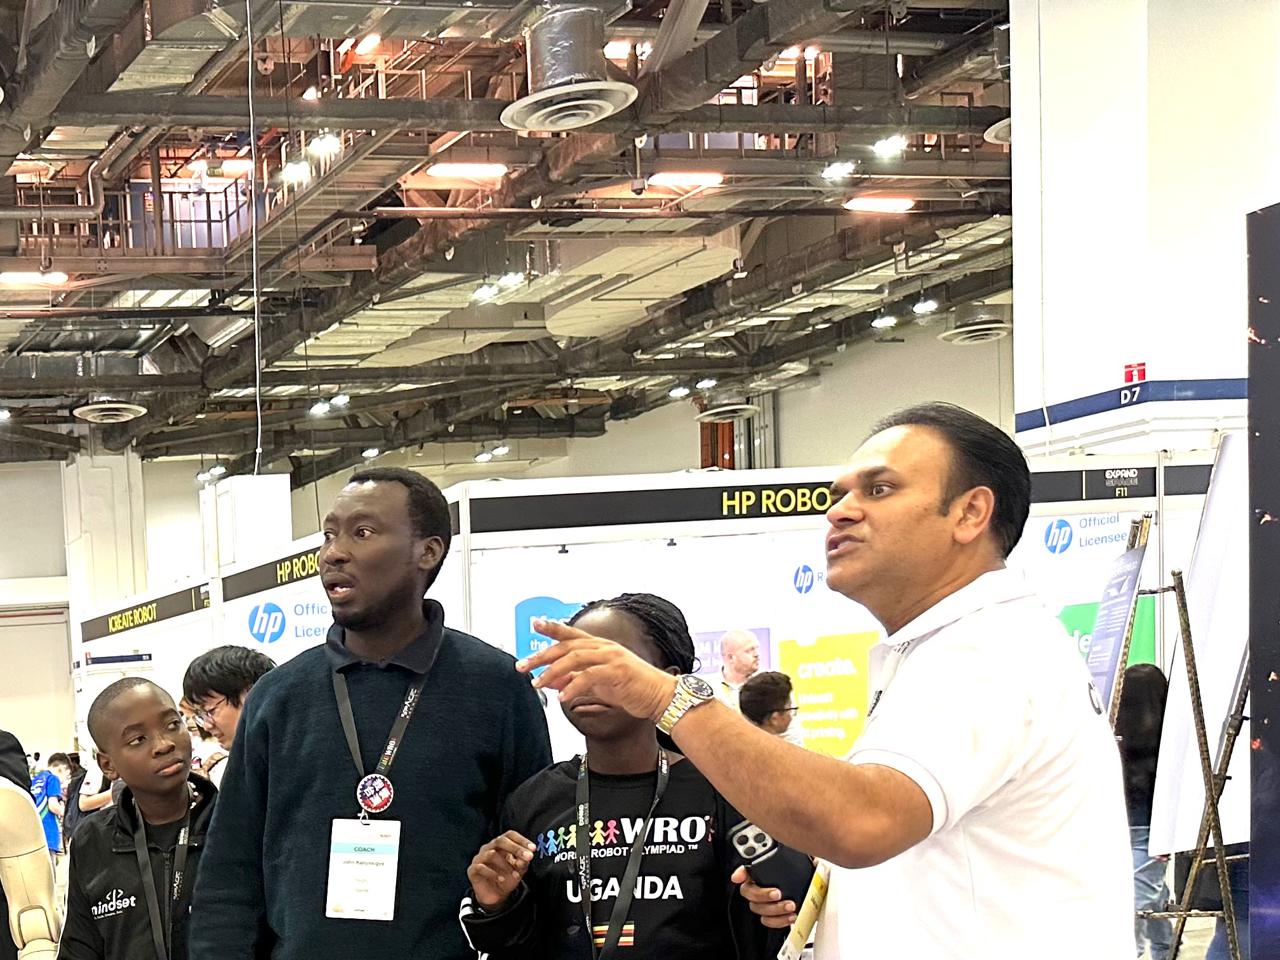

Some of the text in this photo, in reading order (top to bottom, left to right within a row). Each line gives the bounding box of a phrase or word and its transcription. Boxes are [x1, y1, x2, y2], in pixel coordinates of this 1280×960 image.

[1120, 387, 1140, 405] D7
[1105, 469, 1138, 479] EXPAND
[722, 487, 832, 515] HP ROBO
[1115, 486, 1129, 497] F11
[1045, 513, 1120, 554] hp Official
[1079, 532, 1127, 548] Licensee
[276, 560, 291, 584] HP
[793, 565, 814, 594] hp
[108, 602, 157, 633] ICREATE ROBOT
[249, 602, 286, 643] hp
[620, 816, 705, 844] WRO
[554, 851, 577, 863] WOR
[591, 846, 629, 858] ROBOT
[631, 844, 685, 856] YMPIAD
